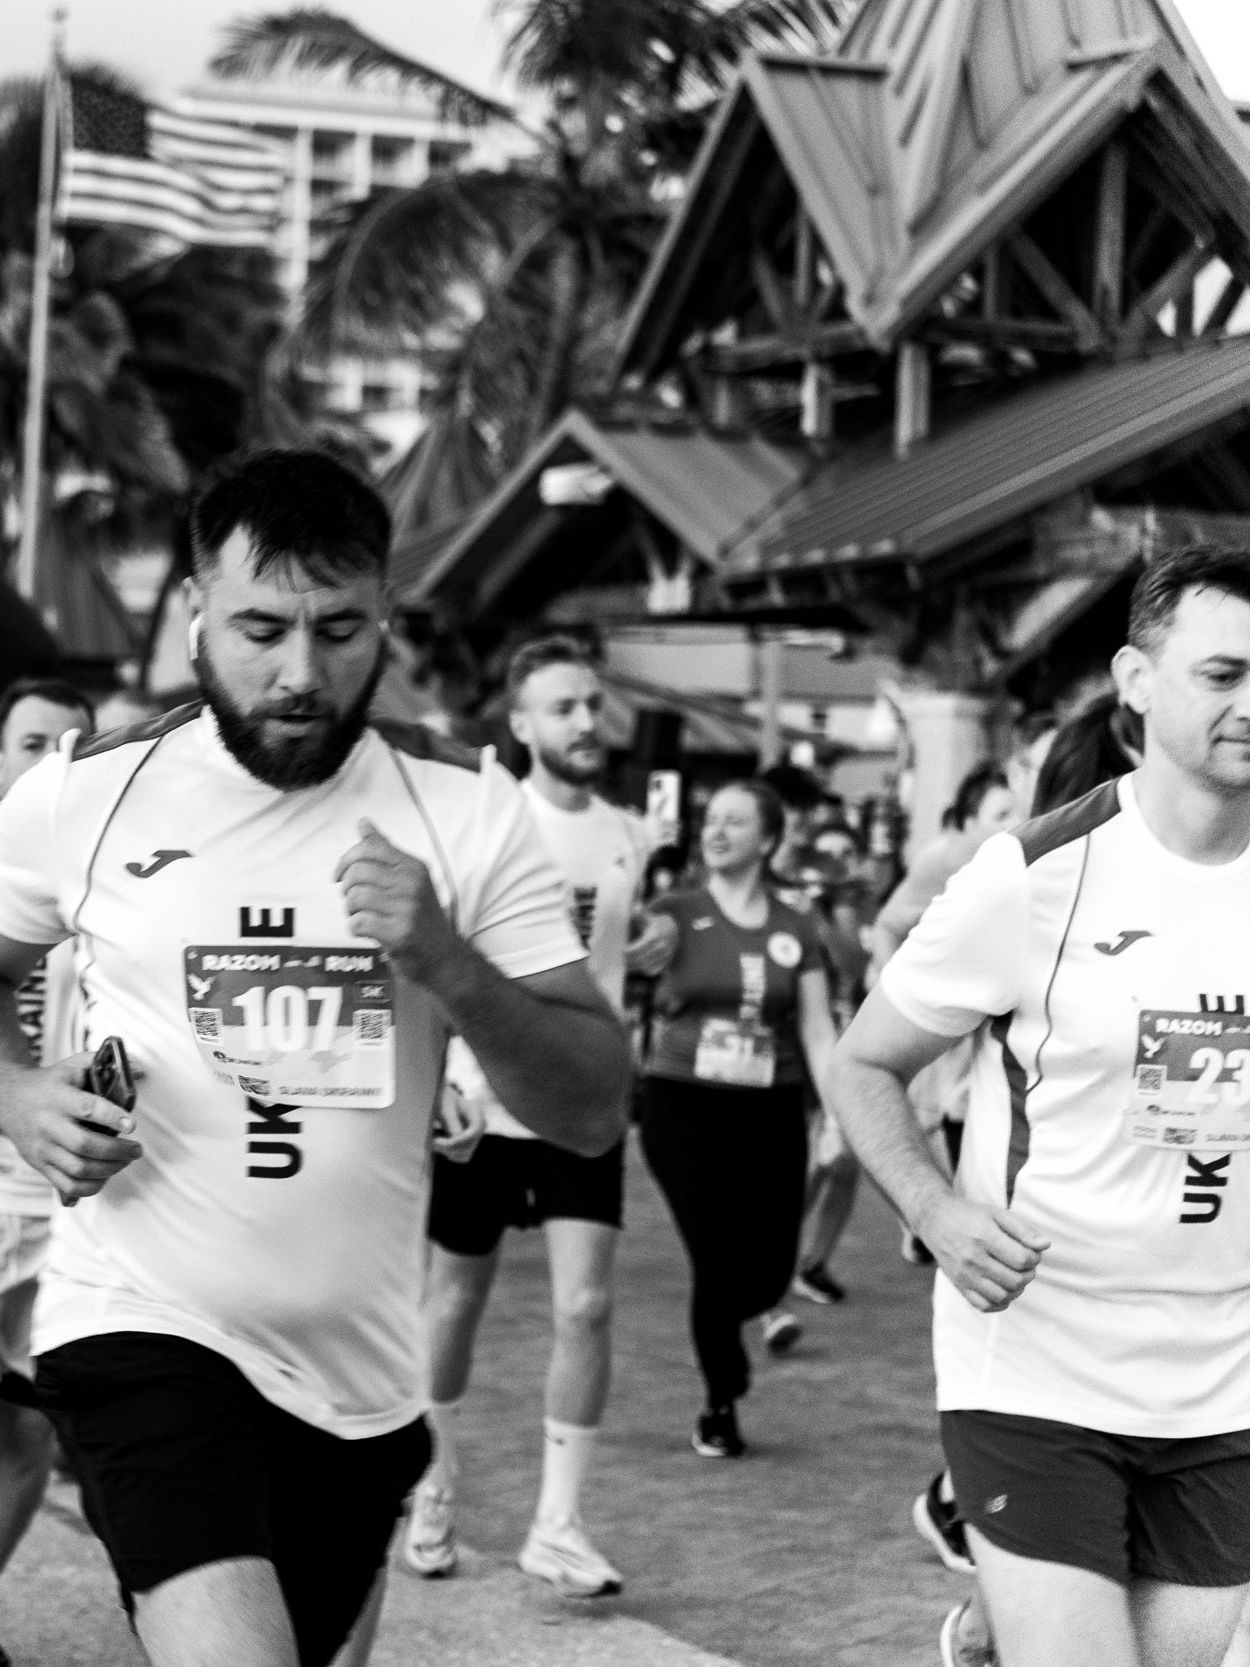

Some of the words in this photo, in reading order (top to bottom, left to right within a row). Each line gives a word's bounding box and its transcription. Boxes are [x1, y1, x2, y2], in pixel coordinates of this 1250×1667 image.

[202, 955, 281, 971] RAZOM
[325, 956, 374, 972] RUN
[232, 985, 343, 1051] 107
[1156, 1018, 1222, 1036] RAZOM
